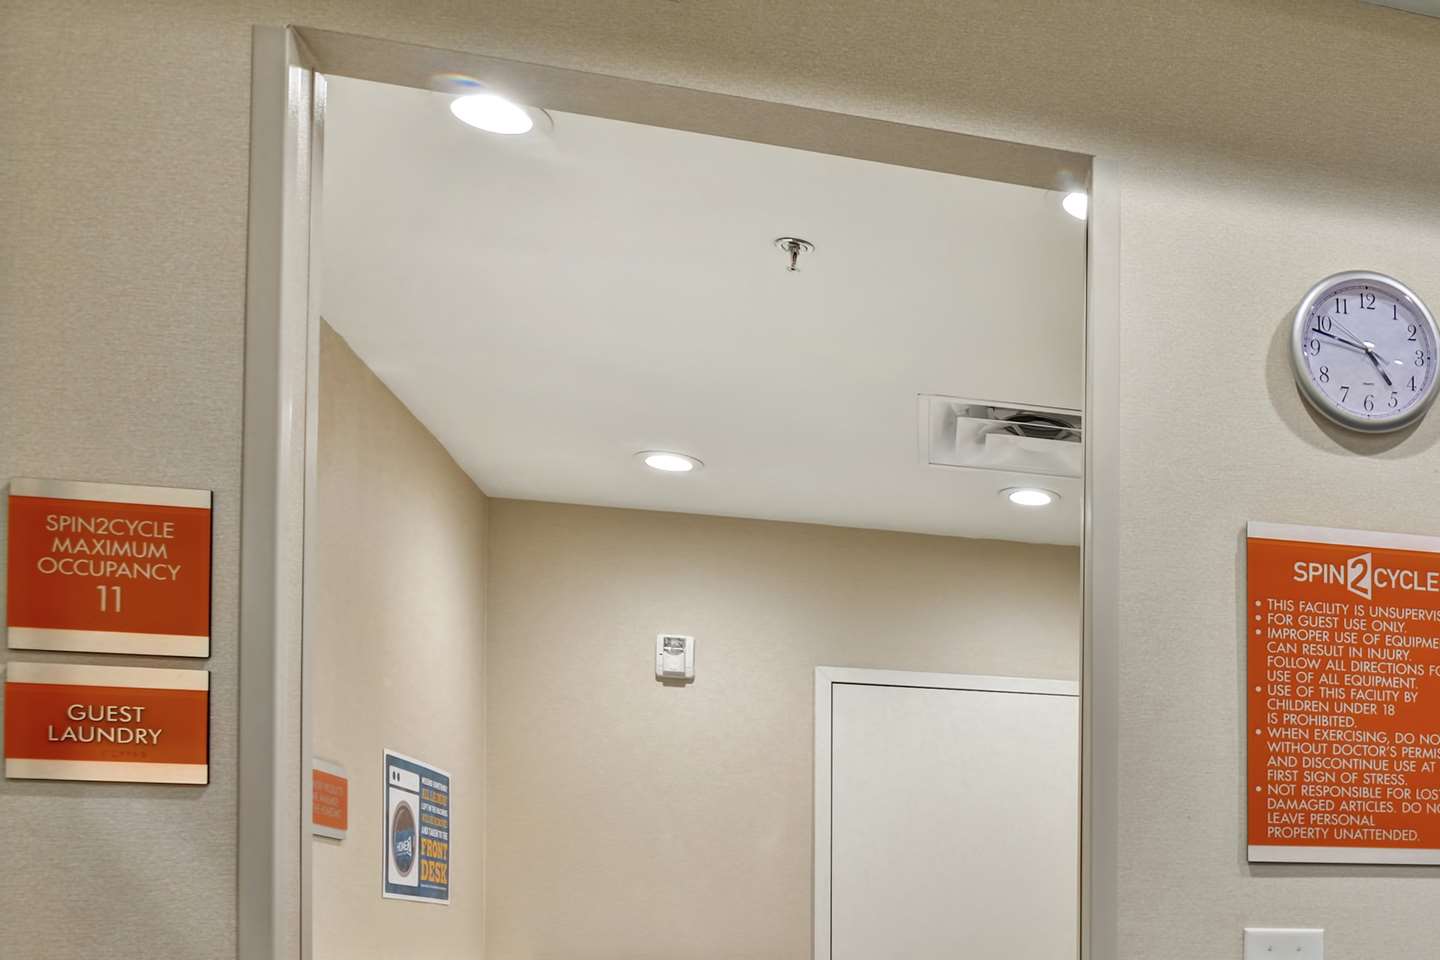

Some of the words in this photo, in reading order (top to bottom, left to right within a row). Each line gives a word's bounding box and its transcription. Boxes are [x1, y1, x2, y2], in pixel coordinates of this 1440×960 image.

[1335, 298, 1348, 314] 11
[1360, 293, 1375, 310] 12
[1392, 305, 1398, 320] 1
[1317, 315, 1331, 331] 10
[1408, 325, 1417, 341] 2
[1310, 340, 1320, 356] 9
[1415, 351, 1424, 367] 3
[1319, 366, 1330, 382] 8
[1407, 376, 1417, 391] 4
[1340, 386, 1350, 402] 7
[1388, 392, 1398, 408] 5
[1364, 395, 1374, 411] 6
[46, 514, 175, 539] SPIN2CYCLE
[52, 539, 168, 559] MAXIMUM
[37, 556, 181, 580] OCCUPANCY
[96, 585, 121, 612] 11
[1268, 599, 1294, 612] THIS
[1299, 601, 1348, 614] FACILITY
[1355, 605, 1364, 615] IS
[1268, 614, 1292, 625] FOR
[1298, 615, 1339, 629] GUEST
[1344, 618, 1366, 630] USE
[1268, 628, 1329, 642] IMPROPER
[1335, 633, 1357, 643] USE
[1363, 633, 1380, 645] OF
[1267, 642, 1296, 654] CAN
[1303, 644, 1343, 657] RESULT
[1349, 647, 1362, 658] IN
[1268, 656, 1320, 669] FOLLOW
[1325, 660, 1346, 671] ALL
[1351, 661, 1424, 676] DIRECTIONS
[1267, 671, 1291, 682] USE
[1296, 672, 1313, 683] OF
[1319, 674, 1339, 685] ALL
[1268, 685, 1291, 696] USE
[1296, 686, 1314, 697] OF
[1320, 688, 1345, 699] THIS
[1351, 689, 1399, 702] FACILITY
[1405, 692, 1417, 703] BY
[67, 704, 145, 722] GUEST
[1267, 699, 1329, 712] CHILDREN
[1334, 702, 1377, 714] UNDER
[1383, 704, 1395, 716] 18
[1268, 713, 1278, 724] IS
[1283, 714, 1356, 728] PROHIBITED.
[48, 725, 161, 745] LAUNDRY
[1268, 727, 1309, 739] WHEN
[1314, 729, 1389, 744] EXERCISING,
[1395, 733, 1415, 744] DO
[1268, 742, 1328, 754] WITHOUT
[1267, 757, 1297, 768] AND
[1303, 758, 1388, 771] DISCONTINUE
[1394, 760, 1415, 772] USE
[1421, 762, 1435, 772] AT
[1268, 770, 1298, 781] FIRST
[1303, 772, 1335, 783] SIGN
[1340, 773, 1358, 784] OF
[1363, 773, 1408, 785] STRESS.
[1268, 784, 1296, 796] NOT
[1302, 786, 1381, 798] RESPONSIBLE
[1387, 788, 1411, 799] FOR
[1268, 798, 1334, 811] DAMAGED
[1402, 803, 1421, 813] DO
[1268, 813, 1304, 824] LEAVE
[1310, 814, 1375, 826] PERSONAL
[1268, 827, 1329, 839] PROPERTY
[1334, 829, 1420, 841] UNATTENDED.
[421, 838, 448, 860] FRONT
[421, 859, 448, 883] DESK
